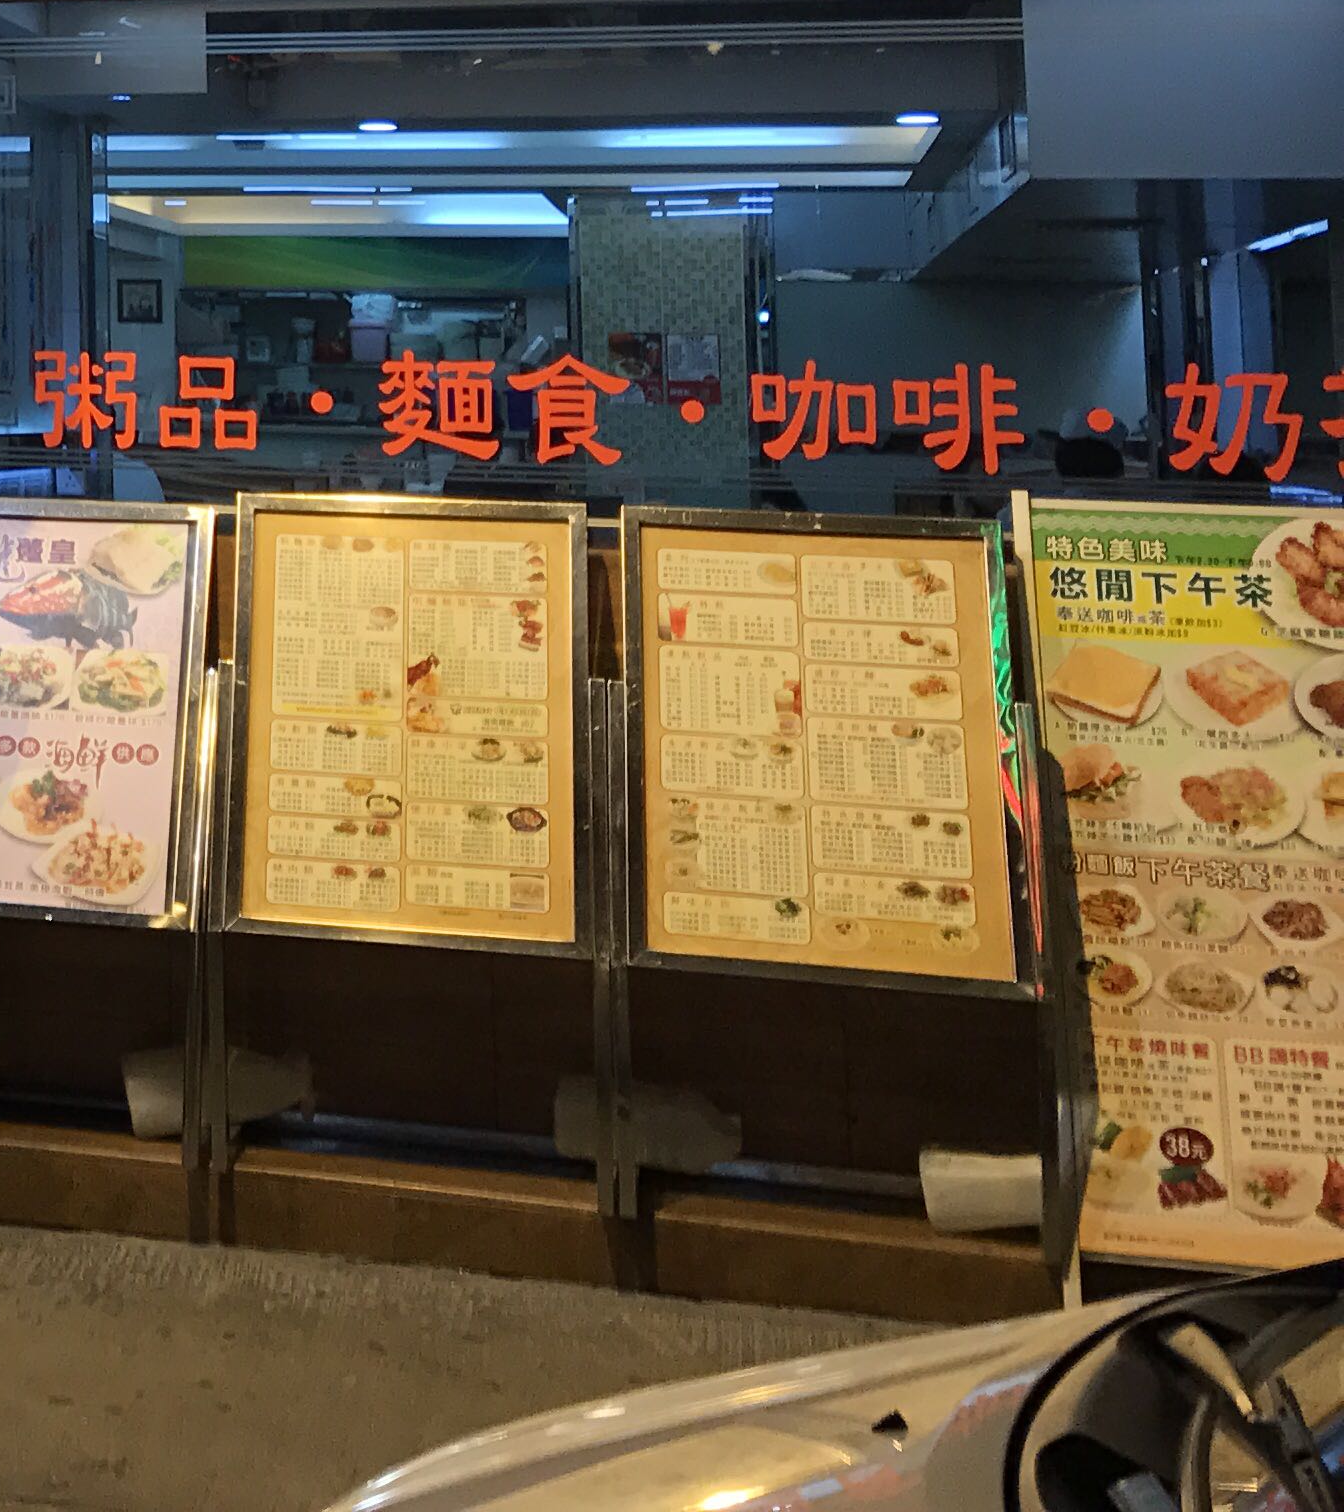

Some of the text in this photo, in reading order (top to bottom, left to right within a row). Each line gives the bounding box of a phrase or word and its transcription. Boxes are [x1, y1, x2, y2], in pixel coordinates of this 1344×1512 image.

[32, 348, 1344, 482] 粥品 麵食 咖啡 奶
[1046, 535, 1168, 564] 特色美味
[1165, 1131, 1208, 1161] 38元
